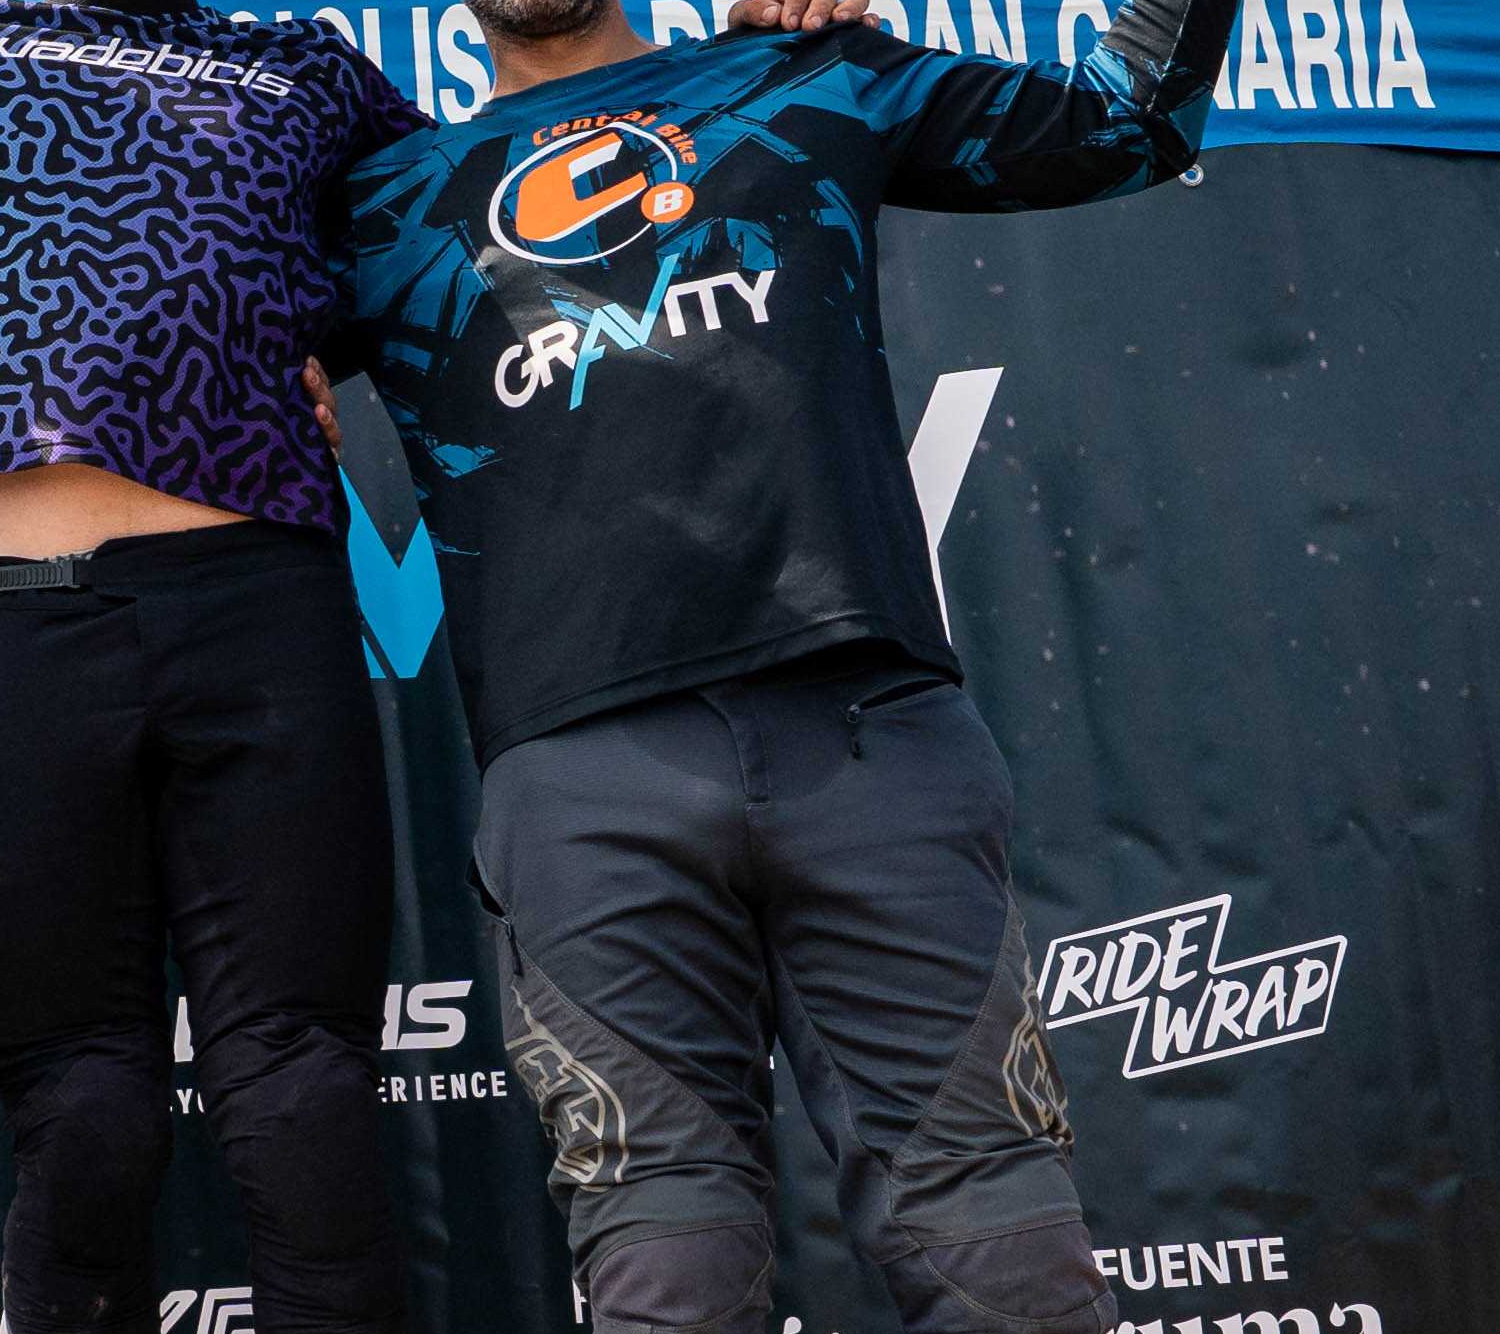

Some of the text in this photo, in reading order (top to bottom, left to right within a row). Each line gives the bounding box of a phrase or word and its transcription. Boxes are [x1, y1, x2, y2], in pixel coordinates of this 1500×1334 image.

[655, 123, 698, 164] Bike
[494, 252, 777, 411] GRAVITY
[1049, 914, 1208, 1016] RIDE
[1151, 957, 1330, 1063] WRAP
[1092, 1236, 1289, 1292] FUENTE
